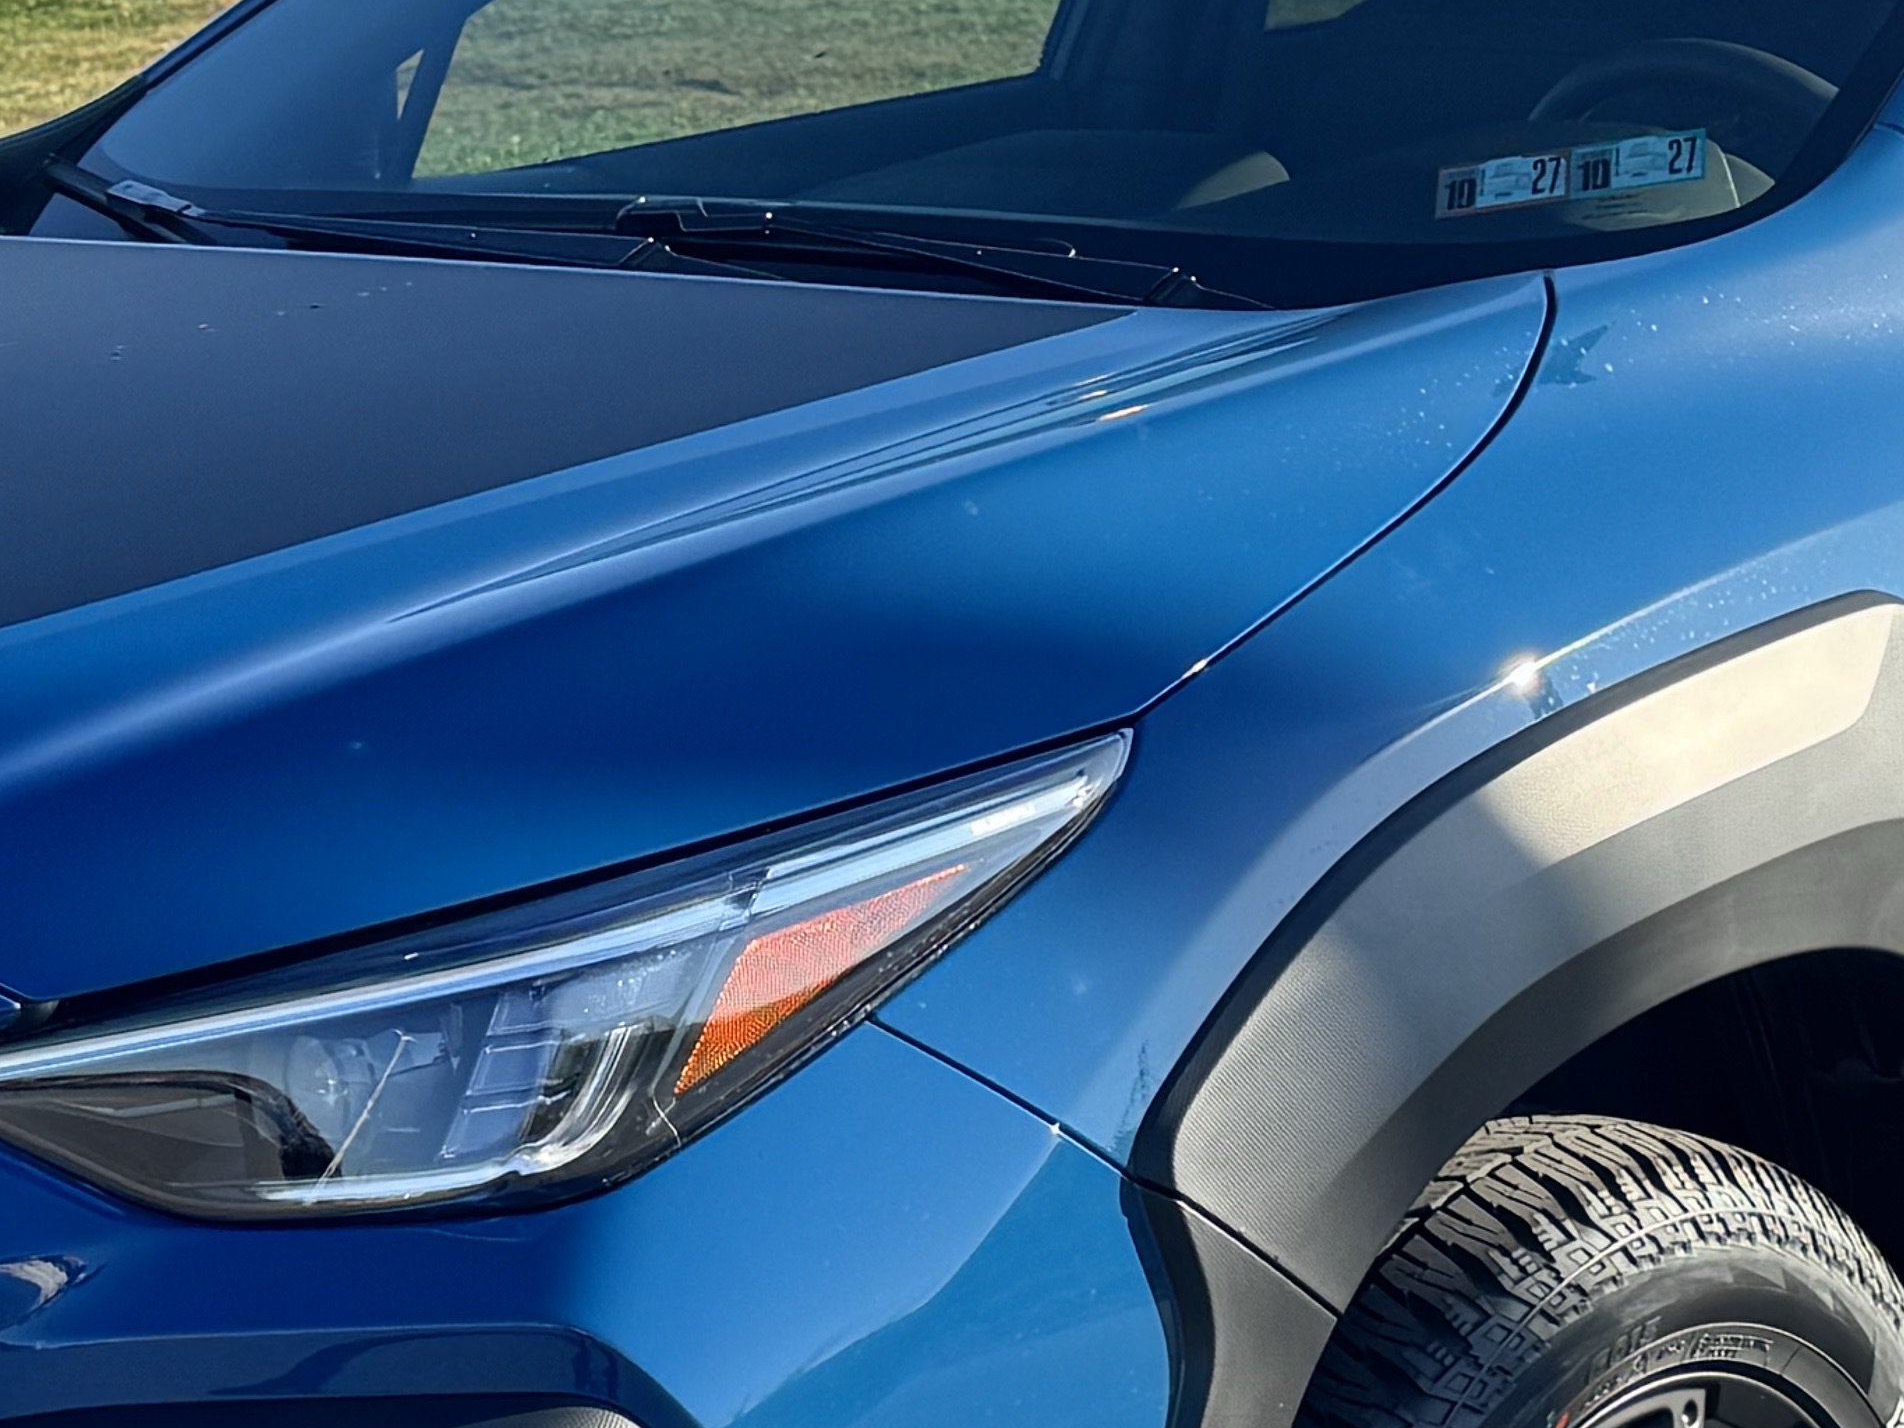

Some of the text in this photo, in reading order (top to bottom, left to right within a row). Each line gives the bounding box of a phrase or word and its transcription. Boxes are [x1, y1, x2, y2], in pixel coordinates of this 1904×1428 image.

[1445, 156, 1562, 211] 10 27
[1578, 136, 1697, 192] 10 27
